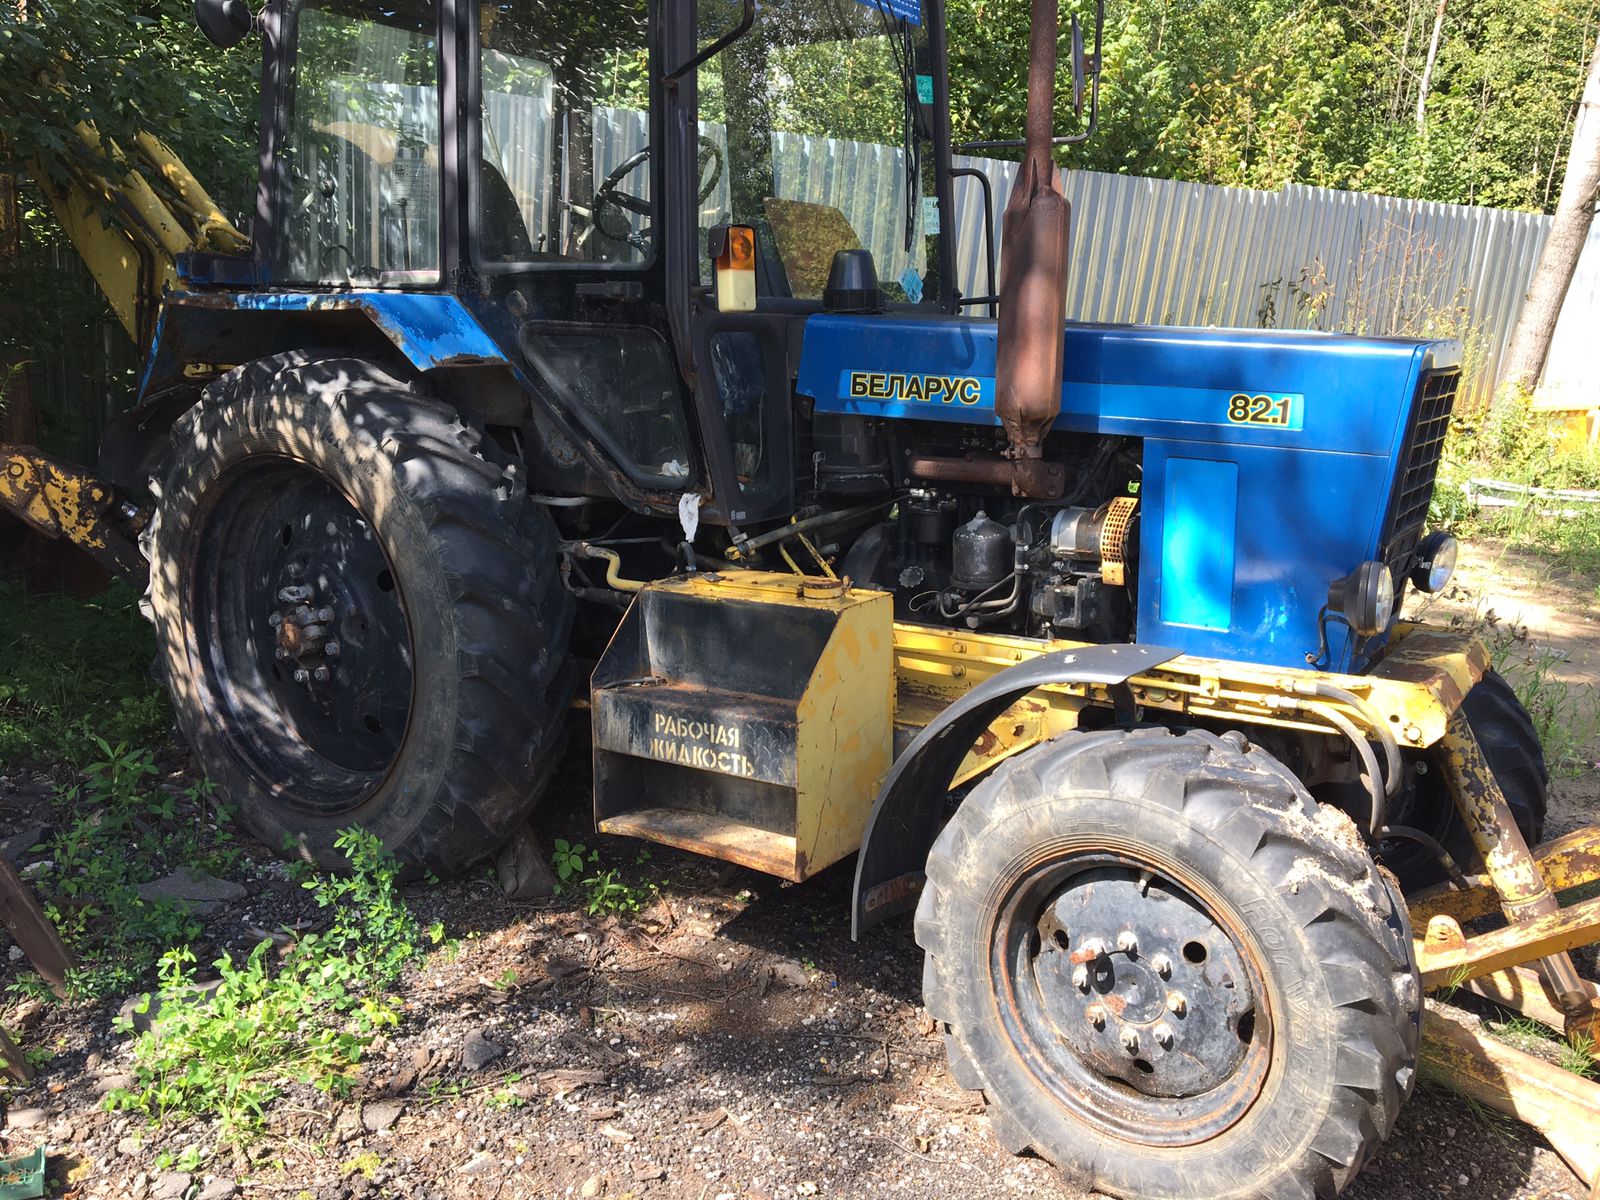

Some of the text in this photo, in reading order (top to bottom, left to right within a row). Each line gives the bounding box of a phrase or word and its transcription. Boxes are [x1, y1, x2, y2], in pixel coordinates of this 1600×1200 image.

[850, 371, 981, 405] БЕЛАРУС
[1228, 392, 1291, 426] 82.1
[654, 713, 740, 748] РАБОЧАЯ
[650, 738, 755, 776] ЖИДКОСТЬ
